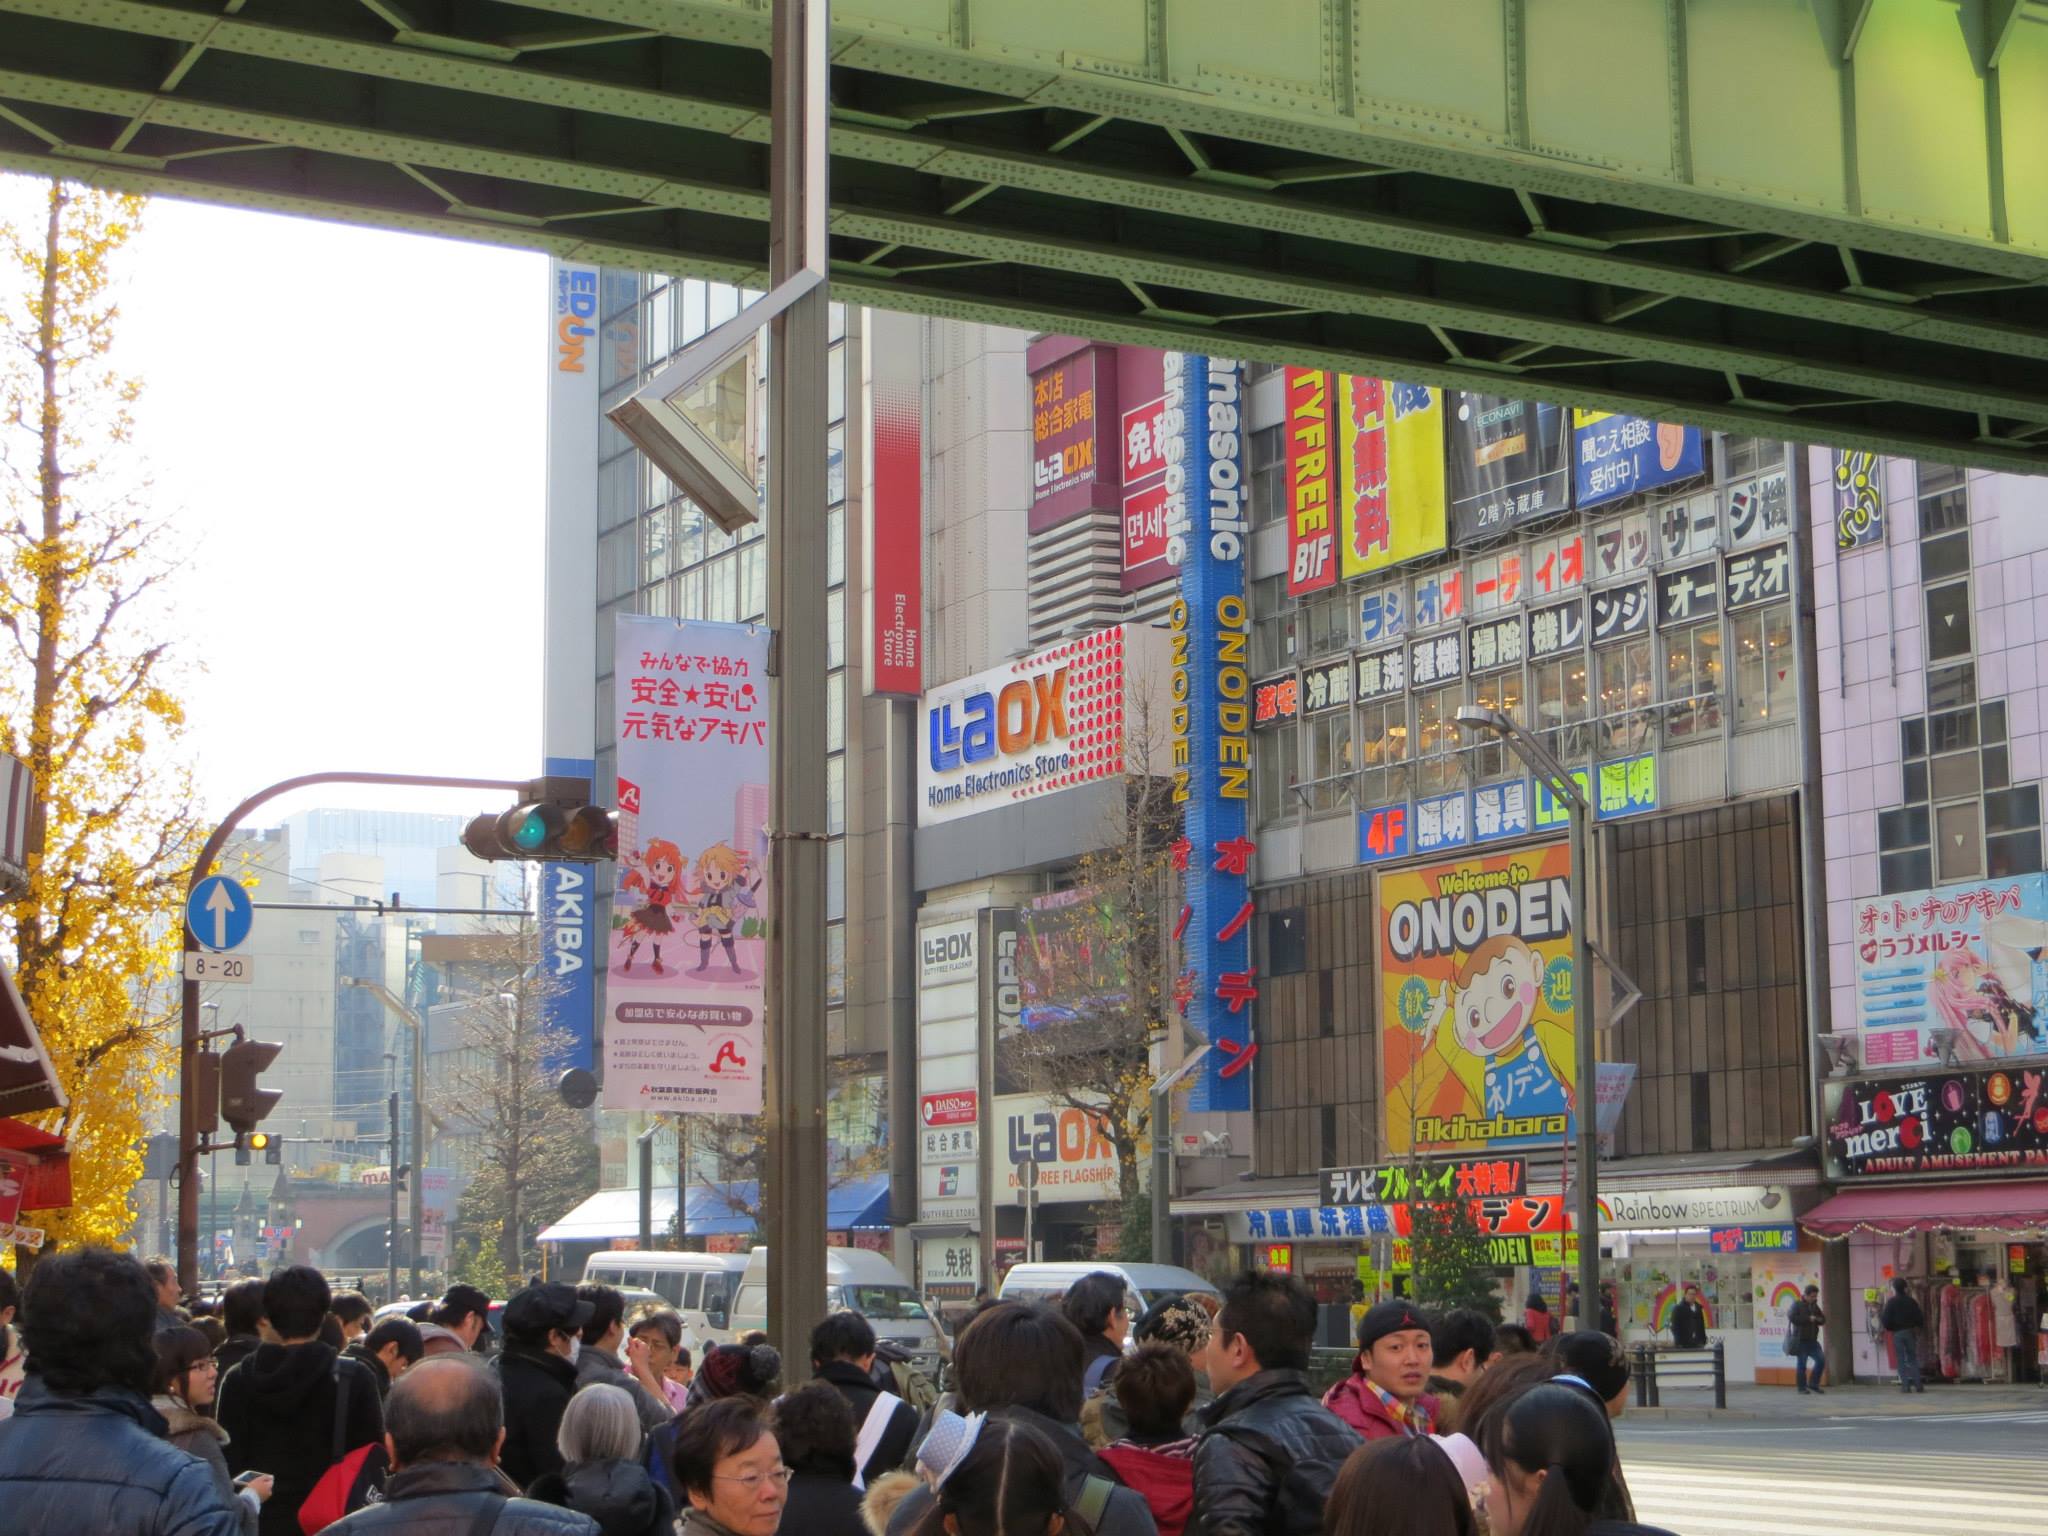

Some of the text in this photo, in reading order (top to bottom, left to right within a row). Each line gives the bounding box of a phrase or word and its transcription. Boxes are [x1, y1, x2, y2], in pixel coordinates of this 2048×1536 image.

[558, 271, 596, 373] EDION
[1035, 371, 1063, 408] 本店
[1035, 390, 1093, 443] 総合家電
[1476, 403, 1520, 428] ECONAVI
[1581, 418, 1651, 466] 聞こえ相談
[1478, 489, 1544, 528] 2階 冷蔵庫
[1293, 535, 1331, 584] B1F
[884, 629, 894, 666] Store
[895, 593, 906, 667] Electronics
[906, 629, 917, 668] Home
[640, 652, 749, 677] みんなで協力
[1170, 597, 1190, 804] ONODEN
[1216, 594, 1250, 799] ONODEN
[622, 711, 766, 746] 元気なアキバ
[928, 752, 1069, 807] Home Electronics Store
[1367, 808, 1405, 855] 4F
[1416, 783, 1527, 848] 照明器具
[1438, 862, 1530, 896] Welcome to
[555, 866, 585, 977] AKIBA
[1388, 876, 1572, 960] ONODEN
[1214, 836, 1258, 1079] オノデン
[1880, 930, 1981, 959] ラブメルシー
[624, 1007, 743, 1022] 加盟店で安心なお買い物
[1487, 1064, 1553, 1113] オノデン
[1858, 1087, 1929, 1125] LOVE
[1415, 1112, 1568, 1143] Akihabara
[1865, 1149, 2048, 1173] ADULT AMUSEMENT PA
[1330, 1169, 1377, 1203] テレビ
[1246, 1204, 1390, 1238] 冷蔵庫 洗濯機
[1613, 1195, 1761, 1221] Rainbow SPECTRUM
[945, 1247, 972, 1278] 免税
